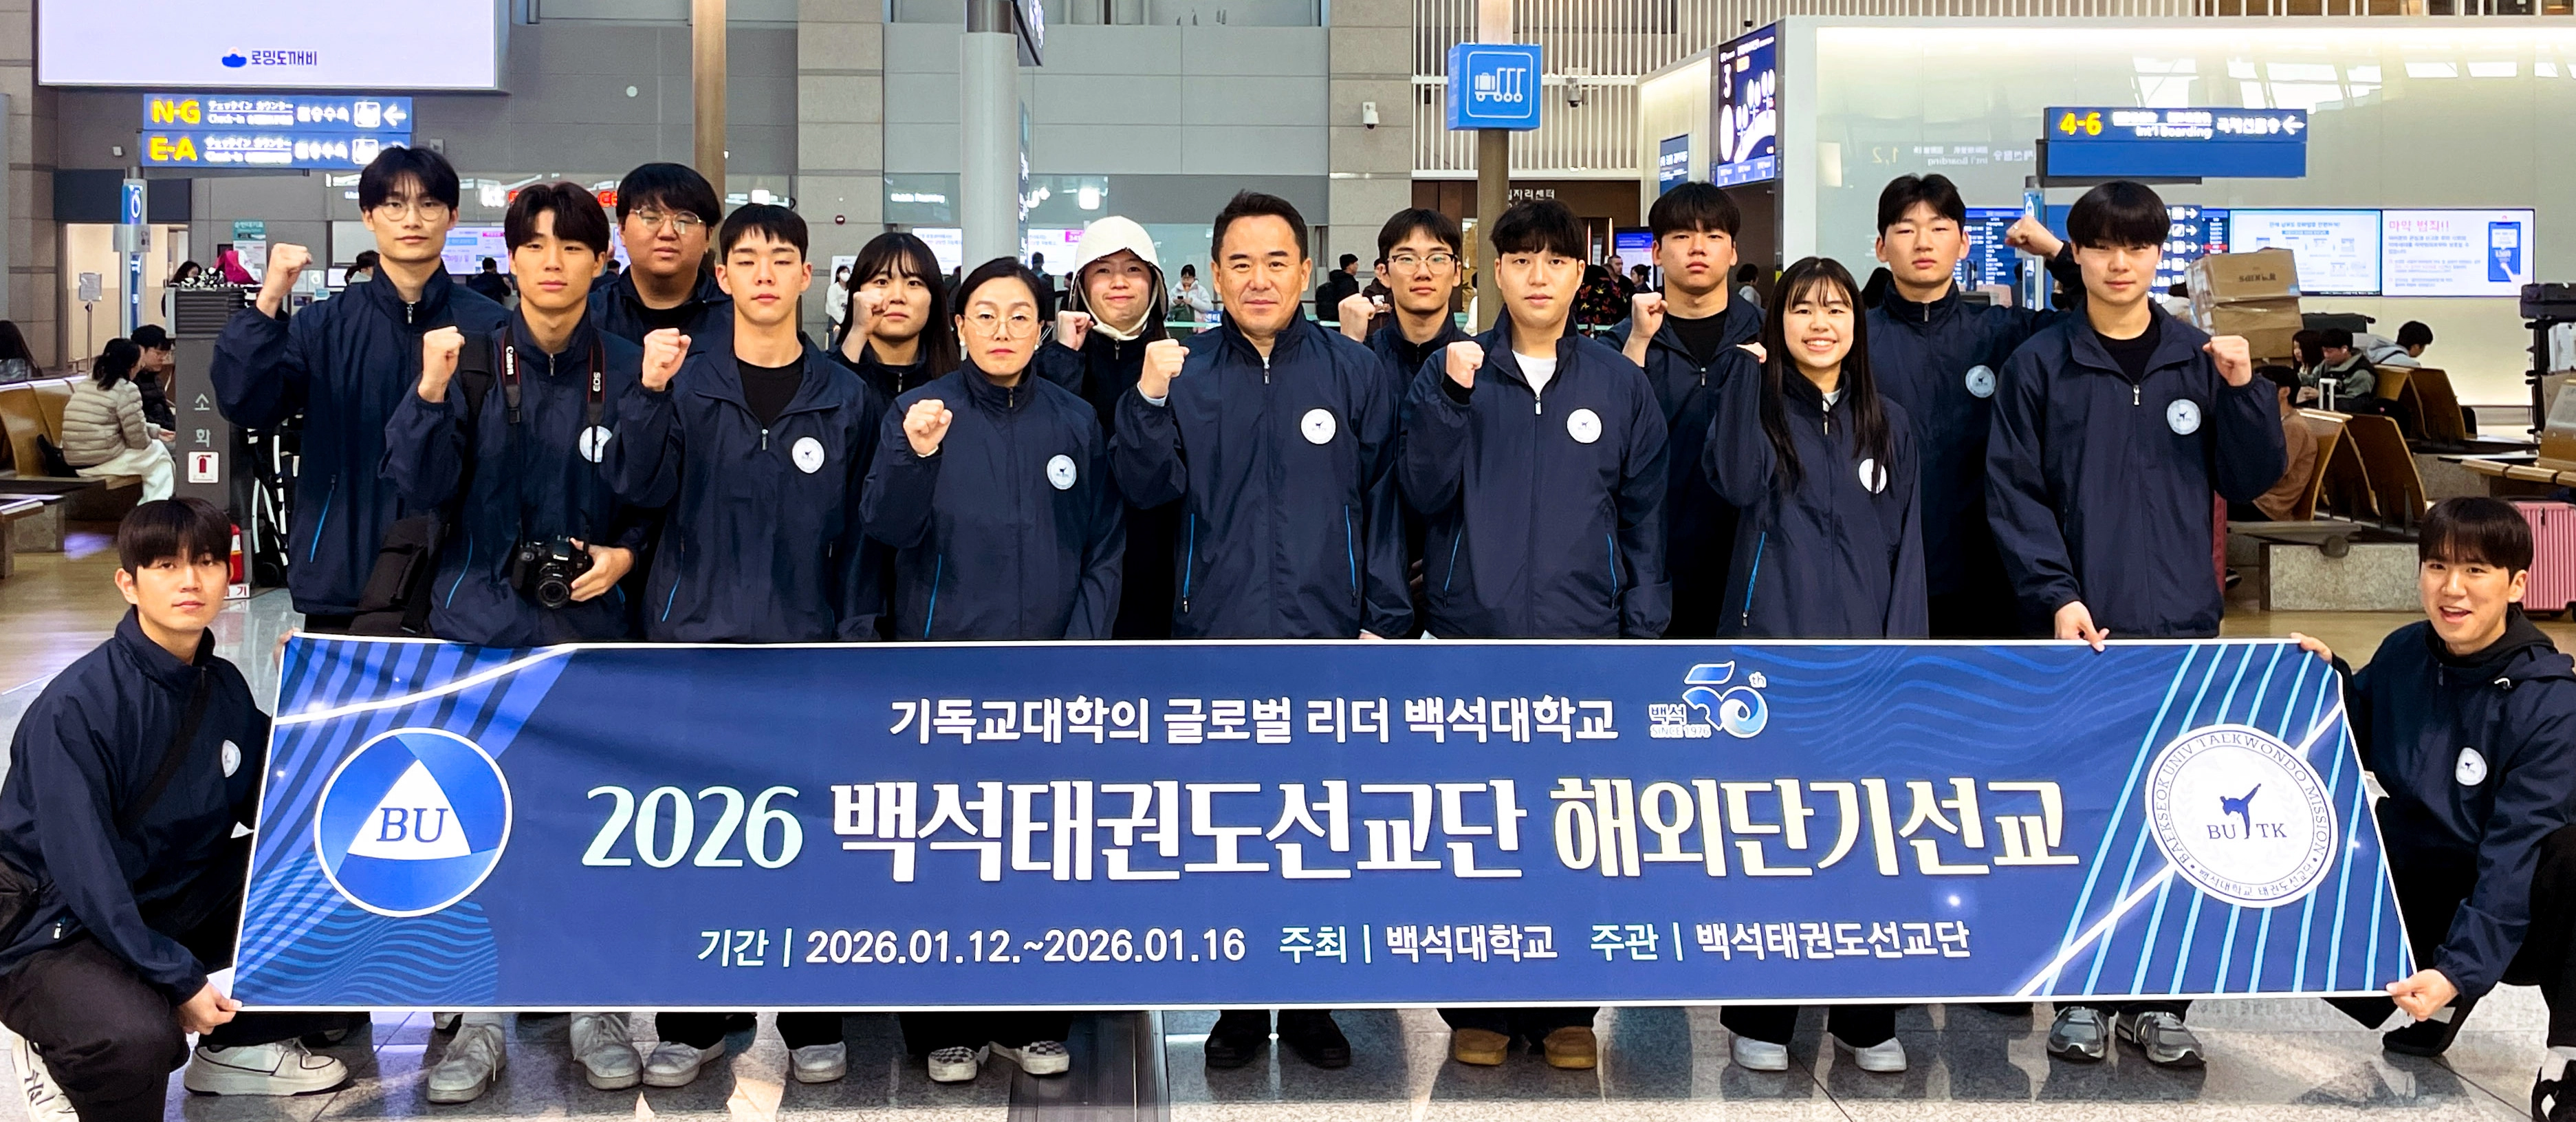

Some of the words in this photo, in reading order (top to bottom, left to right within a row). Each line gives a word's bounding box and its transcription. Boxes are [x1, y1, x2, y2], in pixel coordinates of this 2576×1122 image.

[251, 50, 318, 66] 로밍도깨비
[152, 98, 201, 125] N-G
[2059, 111, 2102, 136] 4-6
[149, 137, 198, 162] E-A
[2389, 219, 2412, 233] 마약
[592, 371, 601, 392] EOS
[889, 695, 1149, 744] 기독교대학의
[1163, 696, 1292, 744] 글로벌
[1307, 696, 1389, 744] 리더
[1404, 694, 1619, 744] 백석대학교
[1650, 704, 1685, 724] 백석
[1651, 725, 1682, 737] SINCE
[1685, 725, 1711, 737] 1976
[2163, 743, 2194, 781] UNIV
[2196, 733, 2307, 783] TAEKWONDO
[376, 808, 449, 843] BU
[582, 785, 803, 869] 2026
[830, 779, 1528, 883] 백석태권도선교단
[1549, 777, 2080, 877] 해외단기선교
[2156, 777, 2191, 865] BAEKSEOK
[2207, 824, 2236, 839] BU
[2256, 823, 2288, 838] TK
[2304, 786, 2328, 856] MISSION
[697, 927, 770, 967] 기간
[806, 927, 1246, 964] 2026.01.12.~2026.01.16
[1279, 924, 1347, 963] 주최
[1385, 923, 1558, 963] 백석대학교
[1589, 923, 1659, 962] 주관
[1695, 920, 1971, 960] 백석태권도선교단
